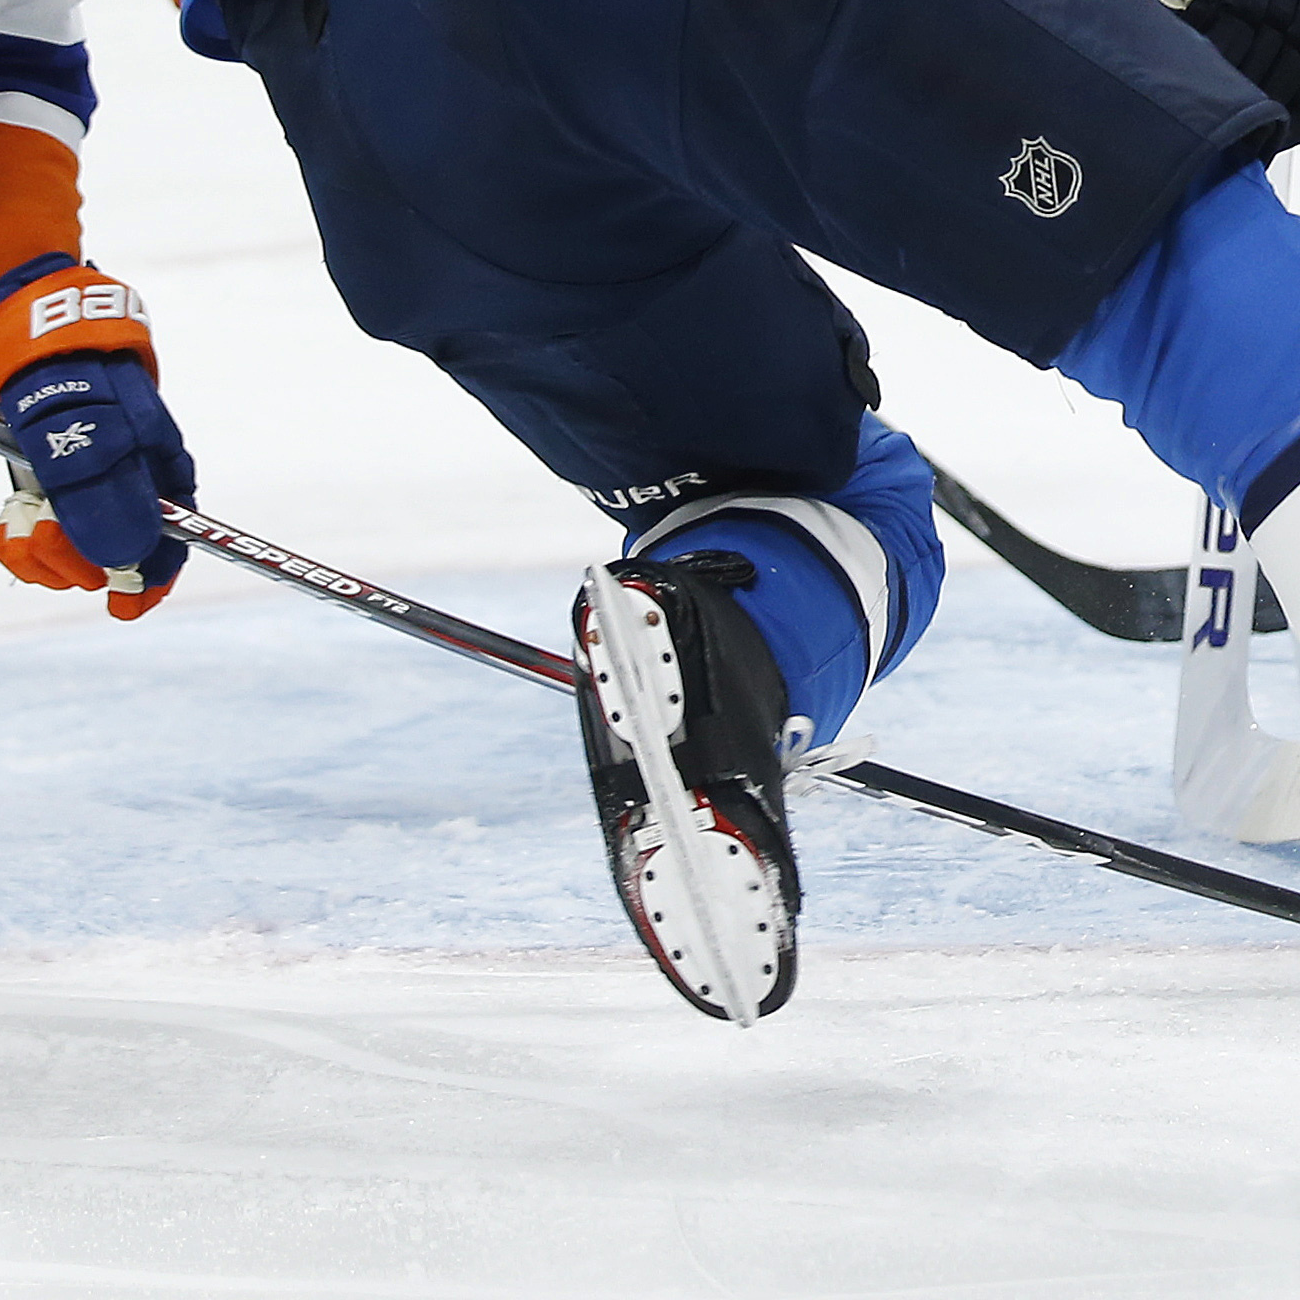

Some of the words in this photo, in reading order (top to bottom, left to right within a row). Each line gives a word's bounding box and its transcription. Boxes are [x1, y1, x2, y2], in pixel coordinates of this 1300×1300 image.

[1034, 157, 1055, 206] NHL
[160, 498, 363, 597] JETSPEED
[367, 591, 411, 616] FT2
